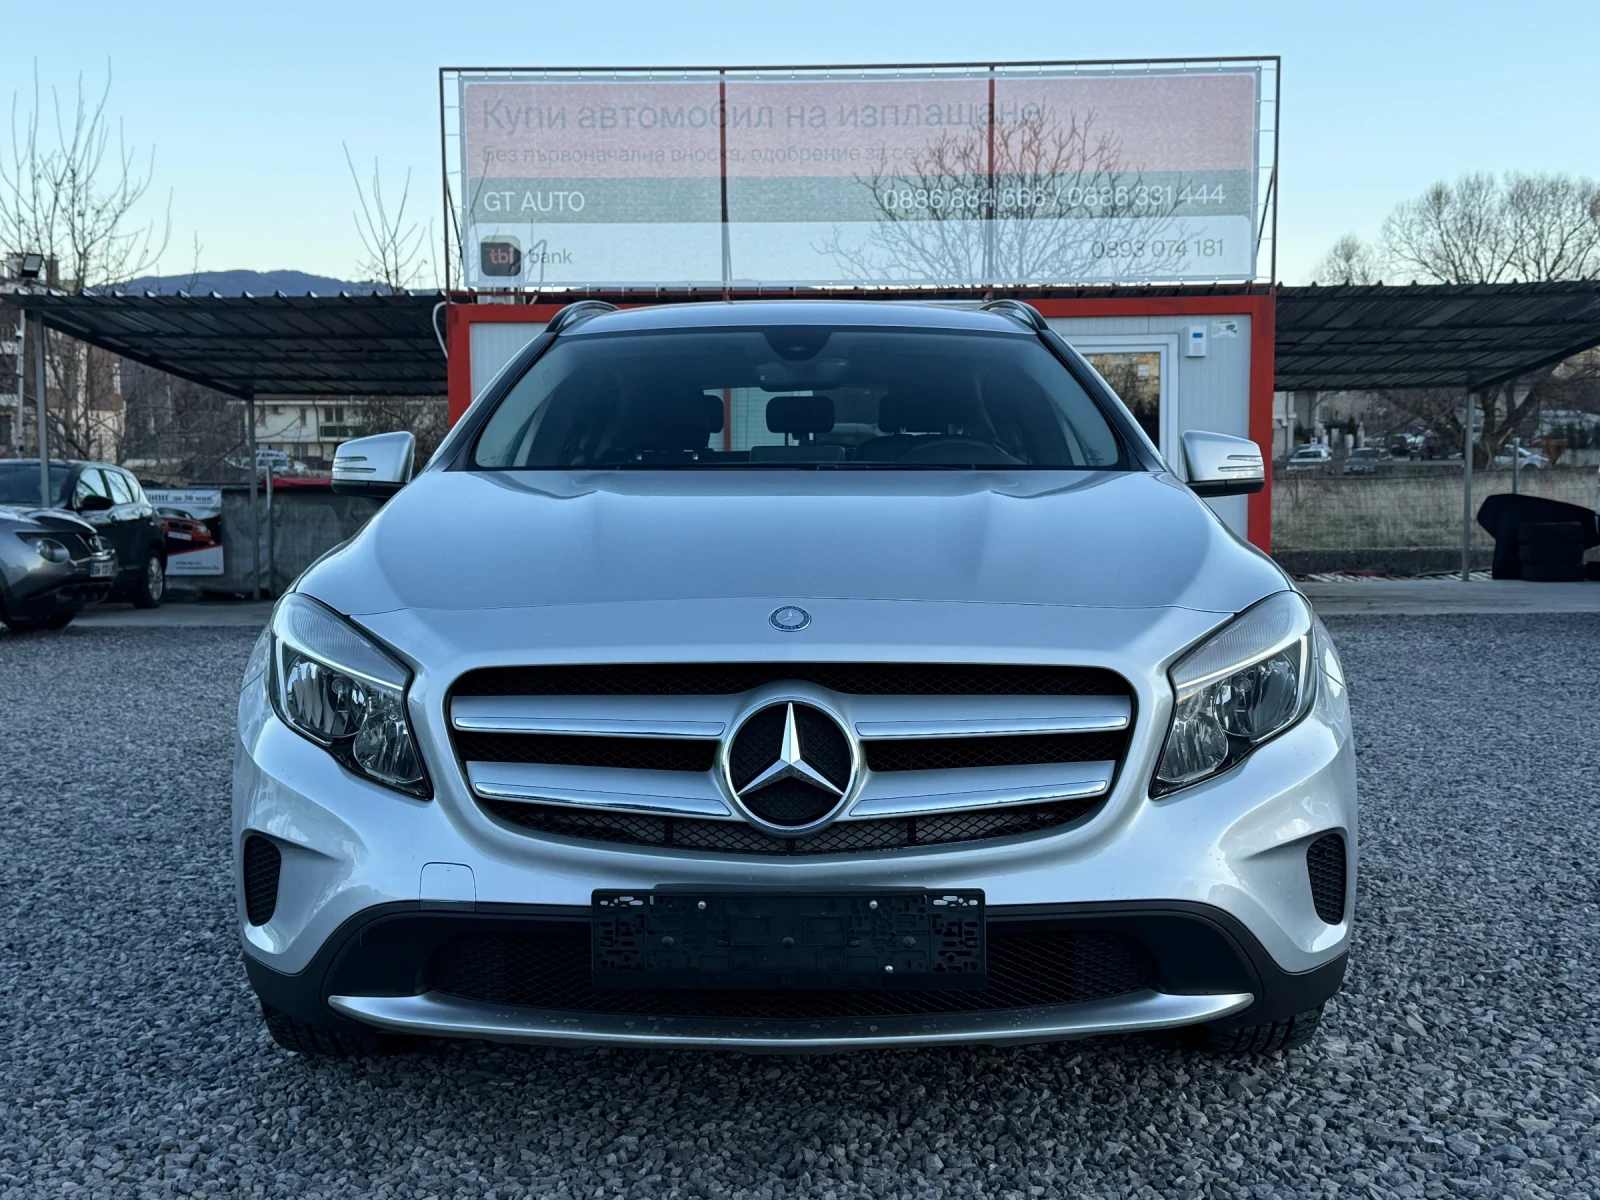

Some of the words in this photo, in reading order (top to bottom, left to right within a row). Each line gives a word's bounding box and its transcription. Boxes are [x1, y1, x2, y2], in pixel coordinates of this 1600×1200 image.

[483, 99, 567, 135] Купи
[578, 101, 774, 129] автомобил
[787, 104, 827, 129] на
[838, 101, 1041, 131] изплащане
[484, 145, 518, 163] Без
[523, 148, 665, 167] първоначална
[751, 146, 861, 165] одобрение
[483, 191, 516, 212] GT
[521, 191, 585, 212] AUTO
[883, 188, 944, 209] 0886
[951, 188, 996, 209] 884
[1002, 187, 1047, 208] 666
[1068, 186, 1129, 207] 0886
[1135, 185, 1172, 206] 331
[1179, 184, 1226, 205] 444
[489, 247, 514, 265] tbi
[528, 248, 573, 265] bank
[1091, 240, 1145, 259] 0893
[1151, 239, 1188, 258] 074
[1194, 238, 1223, 257] 181
